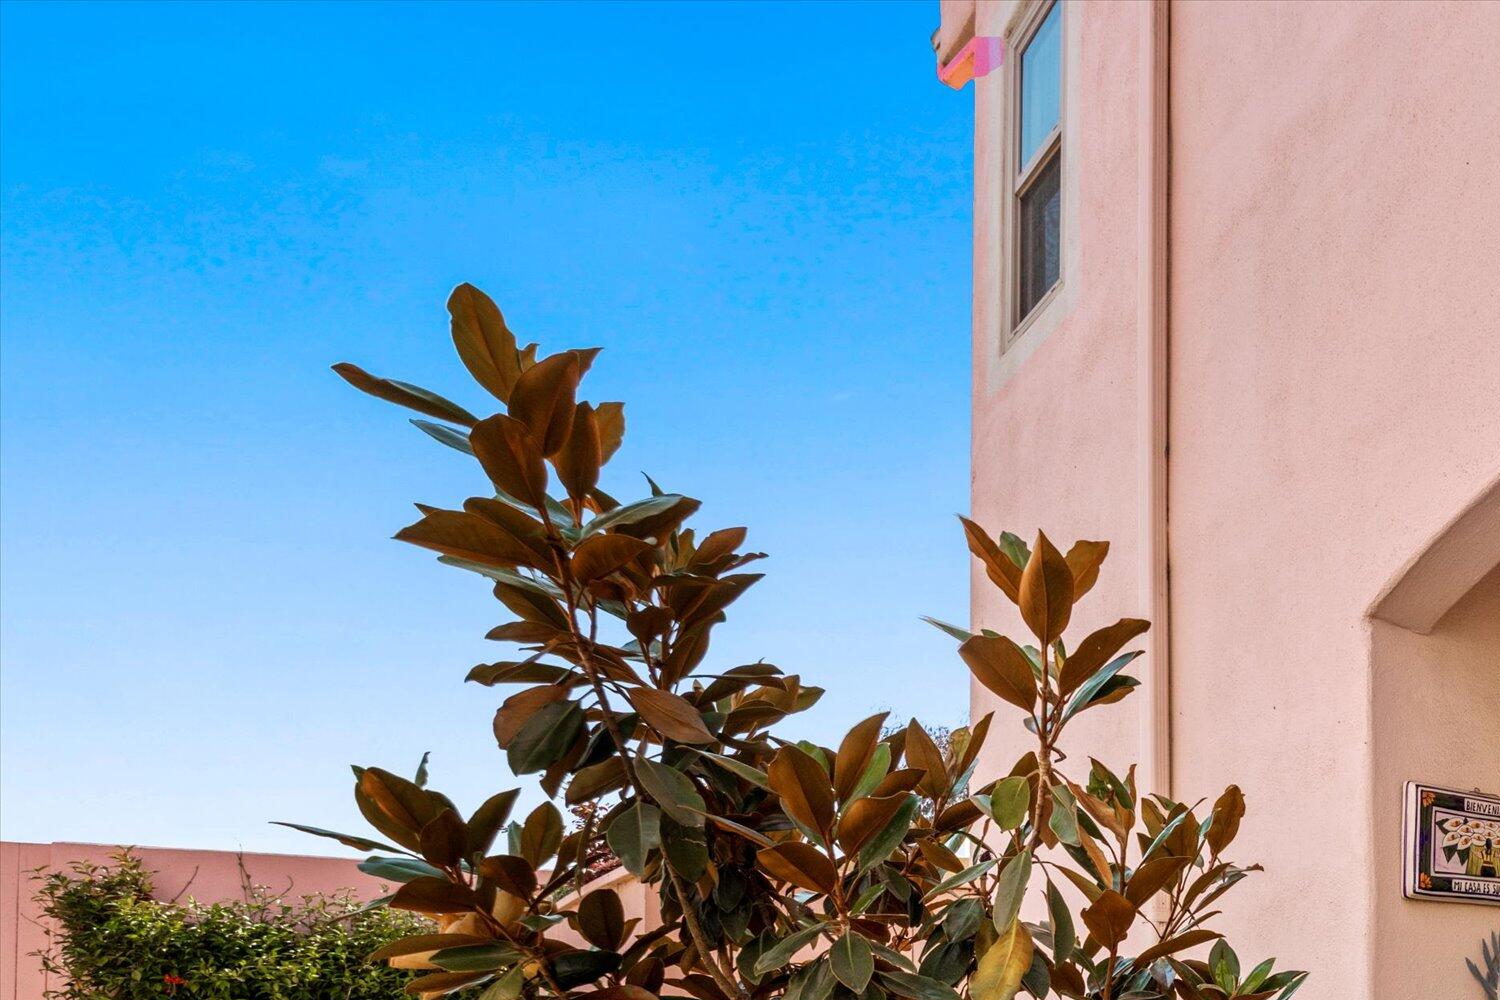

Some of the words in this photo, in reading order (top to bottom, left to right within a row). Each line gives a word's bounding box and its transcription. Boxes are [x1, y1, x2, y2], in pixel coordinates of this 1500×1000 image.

[1454, 881, 1462, 891] MI
[1464, 882, 1481, 893] CASA
[1483, 883, 1490, 894] ES
[1492, 884, 1500, 895] SU
